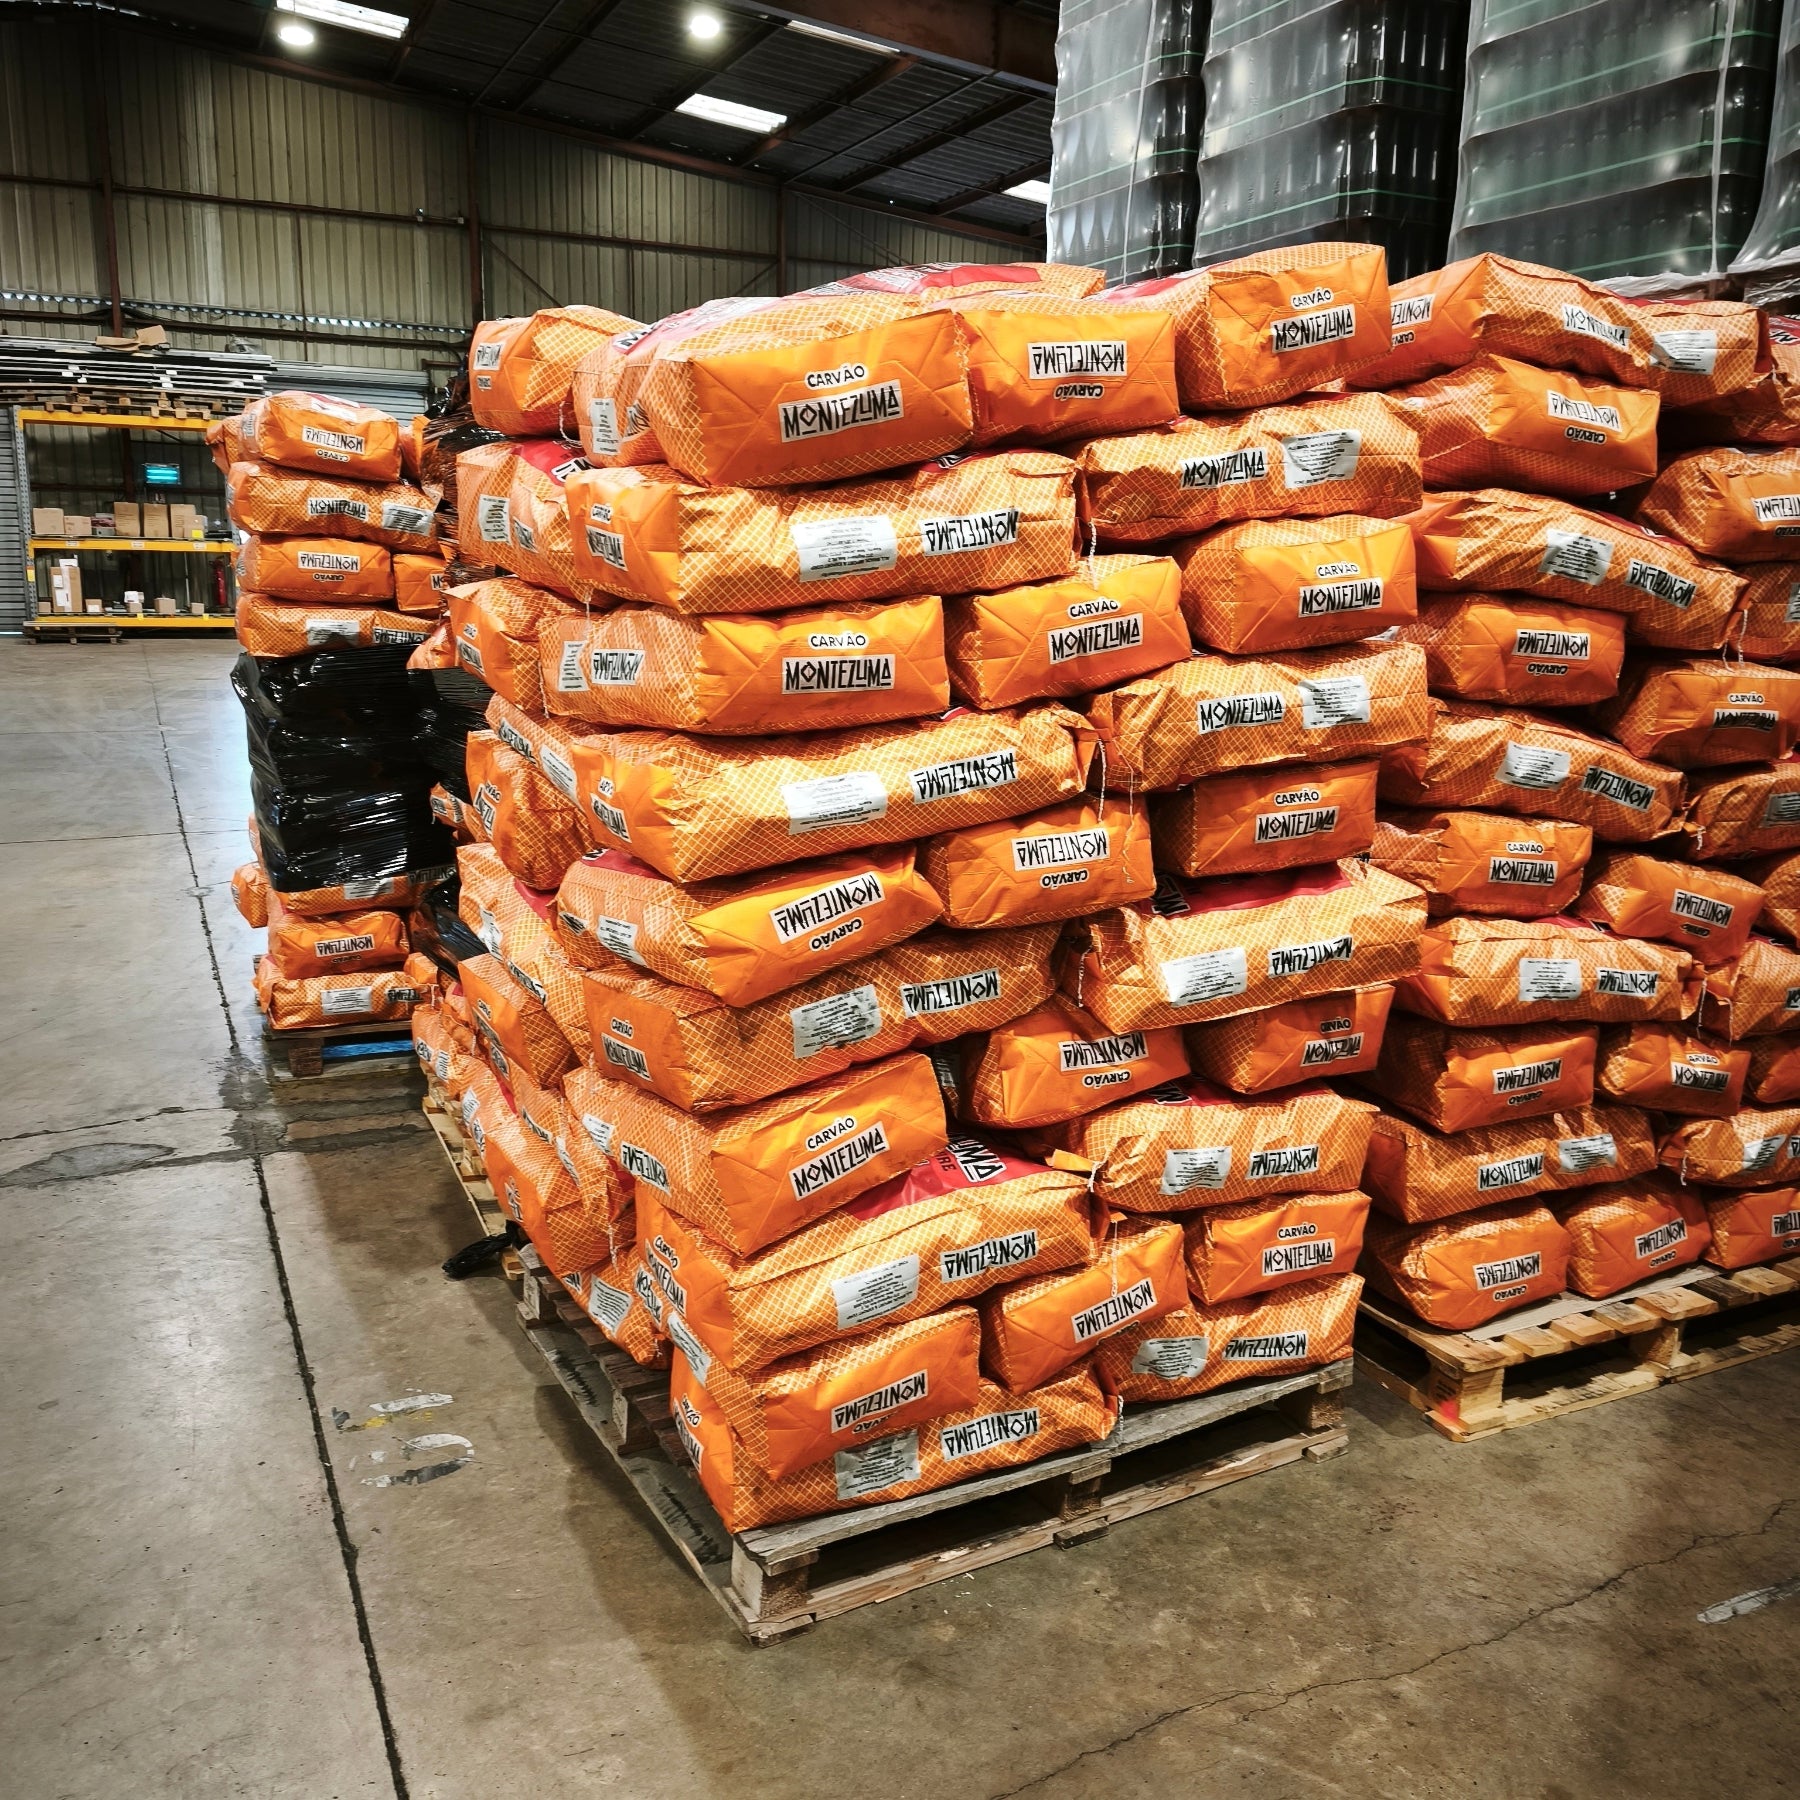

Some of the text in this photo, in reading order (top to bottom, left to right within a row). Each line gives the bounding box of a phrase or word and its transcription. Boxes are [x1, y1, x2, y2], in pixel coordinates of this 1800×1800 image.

[1293, 289, 1331, 307] CARVÃO
[1274, 308, 1353, 350] MONTEZUMA
[1564, 306, 1625, 346] MONTEZUMA
[1032, 344, 1124, 374] MONTEZUMA
[808, 365, 865, 388] CARVÃO
[1056, 385, 1103, 399] CARVÃO
[783, 385, 899, 438] MONTEZUMA
[1551, 393, 1619, 428] MONTEZUMA
[305, 428, 364, 452] MONTEZUMA
[1567, 427, 1605, 443] CARVÃO
[1183, 451, 1264, 487] MONTEZUMA
[310, 500, 367, 520] MONTEZUMA
[925, 511, 1018, 552] MONTEZUMA
[301, 554, 359, 570] MONTEZUMA
[1318, 563, 1358, 576] CARVÃO
[1301, 581, 1380, 614] MONTEZUMA
[1631, 562, 1694, 606] MONTEZUMA
[1070, 600, 1118, 617] CARVÃO
[811, 633, 866, 647] CARVÃO
[1051, 618, 1140, 660] MONTEZUMA
[1518, 632, 1588, 656] MONTEZUMA
[786, 659, 890, 690] MONTEZUMA
[1528, 663, 1568, 674] CARVÃO
[1201, 695, 1282, 730] MONTEZUMA
[1729, 693, 1764, 703] CARVÃO
[914, 753, 1016, 799] MONTEZUMA
[1585, 767, 1654, 810] MONTEZUMA
[1275, 790, 1319, 804] CARVÃO
[1258, 810, 1336, 840] MONTEZUMA
[1016, 831, 1107, 866] MONTEZUMA
[1042, 870, 1088, 887] CARVÃO
[1491, 860, 1554, 884] MONTEZUMA
[775, 874, 882, 936] MONTEZUMA
[1676, 892, 1732, 925] MONTEZUMA
[318, 935, 373, 954] MONTEZUMA
[812, 919, 862, 950] CARVÃO
[903, 971, 998, 1011] MONTEZUMA
[1063, 1033, 1146, 1067] MONTEZUMA
[1084, 1071, 1130, 1087] CARVÃO
[1497, 1060, 1561, 1091] MONTEZUMA
[808, 1118, 854, 1149] CARVÃO
[792, 1128, 886, 1197] MONTEZUMA
[1250, 1146, 1318, 1176] MONTEZUMA
[1480, 1155, 1544, 1189] MONTEZUMA
[1279, 1223, 1316, 1238] CARVÃO
[1637, 1220, 1685, 1256] MONTEZUMA
[944, 1232, 1036, 1278] MONTEZUMA
[1264, 1242, 1333, 1273] MONTEZUMA
[1476, 1254, 1540, 1287] MONTEZUMA
[1075, 1281, 1154, 1337] MONTEZUMA
[1224, 1334, 1306, 1358] MONTEZUMA
[835, 1373, 925, 1428] MONTEZUMA
[944, 1410, 1037, 1456] MONTEZUMA
